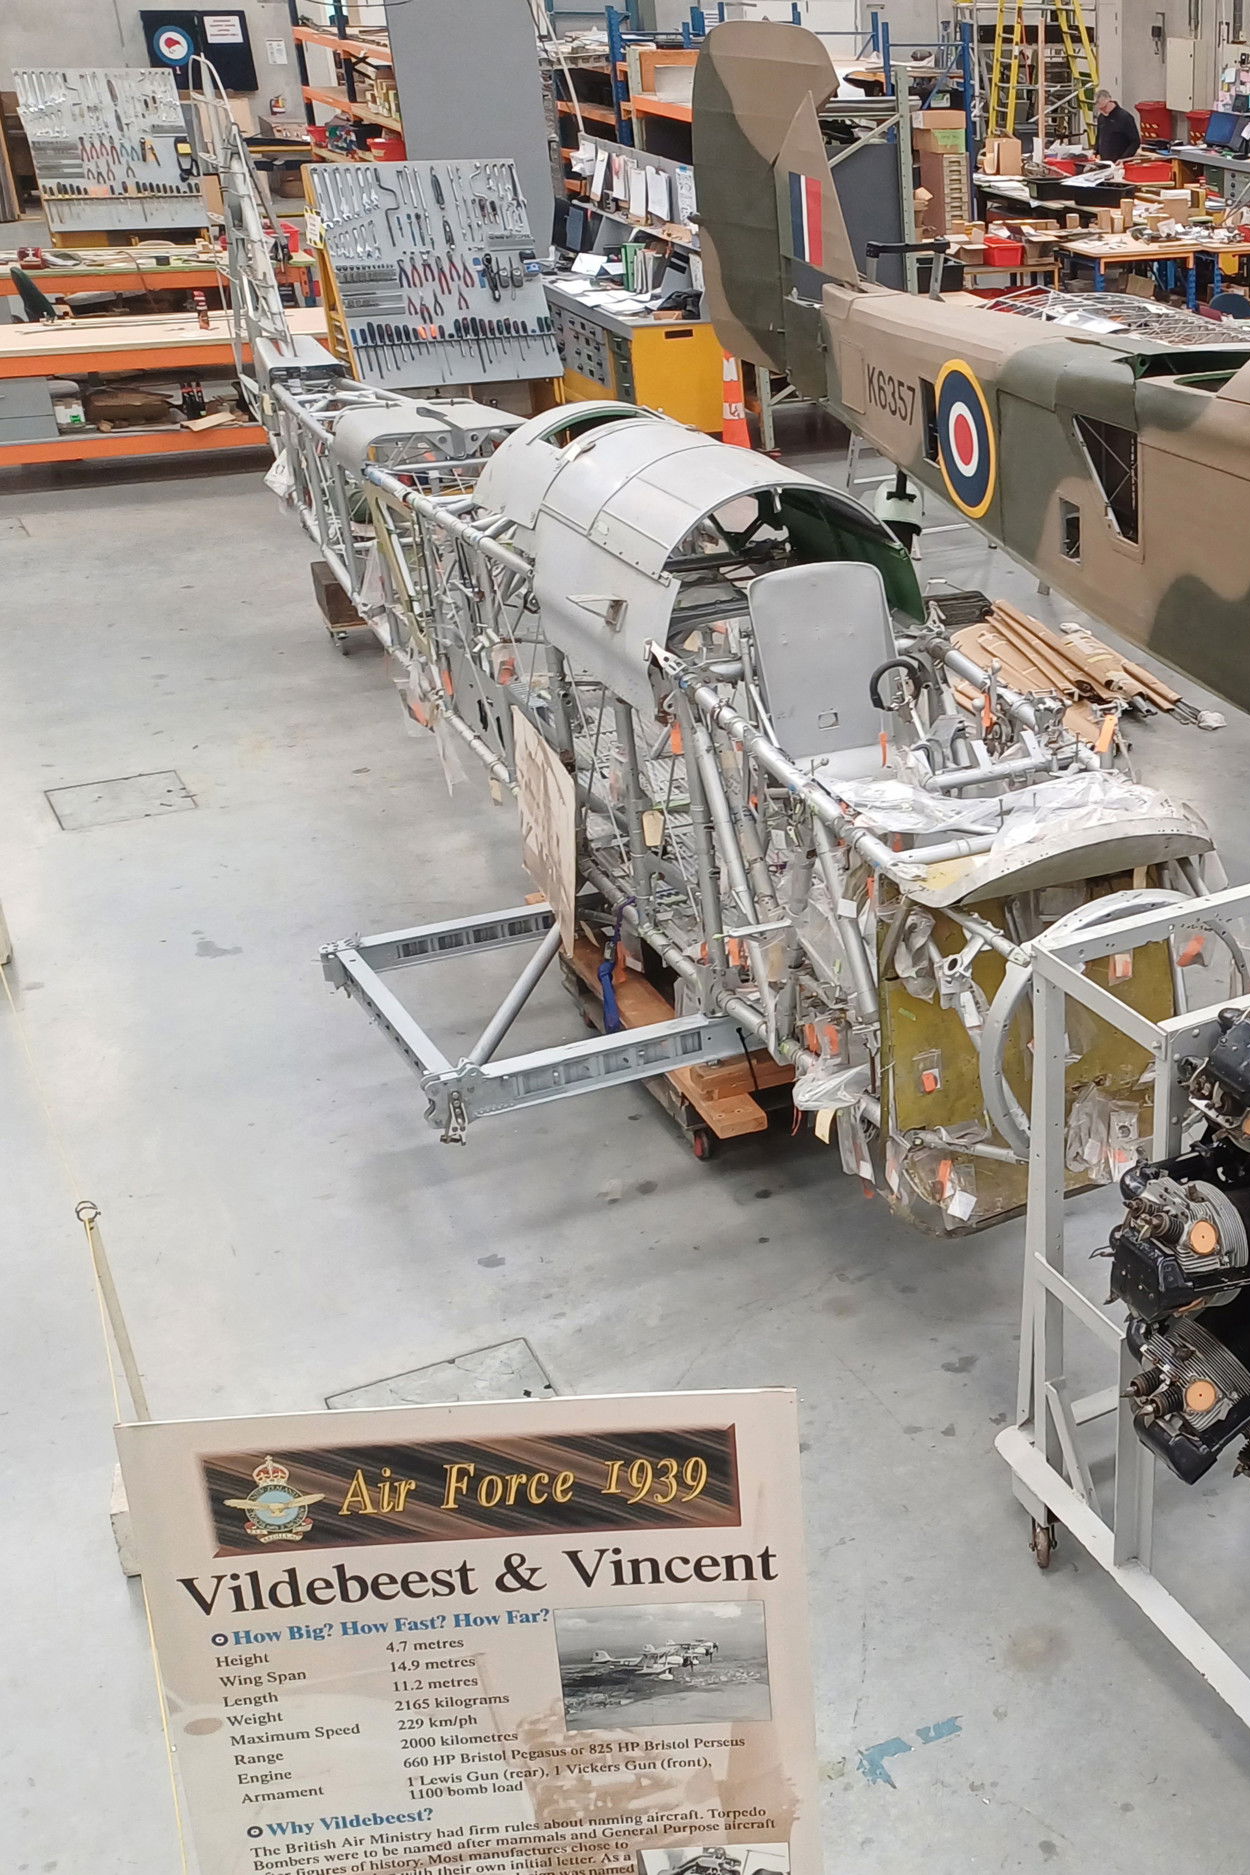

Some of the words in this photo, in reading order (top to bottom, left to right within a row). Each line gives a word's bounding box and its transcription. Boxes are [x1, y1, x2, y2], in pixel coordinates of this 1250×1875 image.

[867, 363, 916, 425] K6357
[338, 1466, 418, 1515] Air
[440, 1463, 576, 1509] Force
[601, 1456, 709, 1504] 1939
[176, 1559, 479, 1616] Vildebeest
[494, 1552, 548, 1593] &
[561, 1545, 778, 1588] Vincent
[231, 1630, 282, 1646] How
[286, 1623, 334, 1641] Big?
[339, 1620, 389, 1637] How
[394, 1614, 447, 1633] Fast?
[453, 1612, 501, 1628] How
[505, 1608, 550, 1625] Far?
[385, 1641, 408, 1652] 4.7
[413, 1638, 465, 1651] metres
[215, 1652, 270, 1668] Height
[390, 1659, 420, 1672] 14.9
[425, 1657, 476, 1670] metres
[219, 1674, 263, 1687] Wing
[266, 1670, 307, 1685] Span
[393, 1679, 424, 1692] 11.2
[428, 1676, 478, 1690] metres
[223, 1691, 279, 1708] Length
[394, 1698, 430, 1711] 2165
[435, 1694, 510, 1708] kilograms
[226, 1711, 284, 1727] Weight
[398, 1718, 424, 1731] 229
[429, 1714, 478, 1729] km/ph
[230, 1730, 311, 1746] Maximum
[314, 1723, 361, 1739] Speed
[400, 1736, 436, 1749] 2000
[440, 1731, 519, 1747] kilometres
[233, 1751, 285, 1766] Range
[403, 1755, 429, 1768] 660
[433, 1754, 456, 1766] HP
[460, 1750, 507, 1764] Bristol
[511, 1748, 567, 1761] Pegasus
[570, 1746, 585, 1756] or
[589, 1743, 614, 1755] 825
[617, 1740, 641, 1752] HP
[644, 1738, 689, 1751] Bristol
[694, 1737, 745, 1749] Perseus
[237, 1770, 293, 1785] Engine
[407, 1777, 415, 1787] 1
[420, 1773, 463, 1786] Lewis
[466, 1771, 499, 1782] Gun
[554, 1765, 560, 1776] 1
[566, 1762, 621, 1775] Vickers
[624, 1760, 656, 1771] Gun
[660, 1757, 712, 1771] (front),
[241, 1786, 325, 1804] Armament
[409, 1786, 443, 1800] 1100
[447, 1783, 488, 1797] bomb
[492, 1781, 523, 1793] load
[266, 1821, 315, 1836] Why
[319, 1807, 434, 1831] Vildebeest?
[250, 1846, 281, 1858] The
[286, 1839, 337, 1854] British
[341, 1837, 365, 1848] Air
[370, 1831, 432, 1845] Ministry
[436, 1826, 464, 1839] had
[469, 1825, 500, 1835] firm
[504, 1821, 540, 1833] rules
[543, 1818, 584, 1830] about
[588, 1814, 643, 1826] naming
[646, 1809, 704, 1822] aircraft.
[706, 1806, 767, 1820] Torpedo
[253, 1856, 320, 1871] Bombers
[324, 1851, 359, 1862] were
[364, 1849, 378, 1859] to
[382, 1846, 399, 1857] be
[403, 1840, 453, 1855] named
[457, 1838, 492, 1850] after
[496, 1831, 567, 1846] mammals
[570, 1828, 597, 1840] and
[602, 1823, 658, 1838] General
[663, 1822, 720, 1835] Purpose
[724, 1818, 776, 1830] aircraft
[351, 1860, 367, 1872] of
[369, 1857, 424, 1871] history.
[428, 1852, 464, 1866] Most
[469, 1846, 567, 1861] manufactures
[571, 1841, 611, 1853] chose
[615, 1840, 629, 1850] to
[438, 1864, 472, 1875] their
[476, 1862, 506, 1873] own
[510, 1856, 552, 1870] initial
[557, 1855, 596, 1867] letter.
[600, 1853, 619, 1864] As
[623, 1853, 631, 1862] a
[588, 1863, 635, 1875] named
